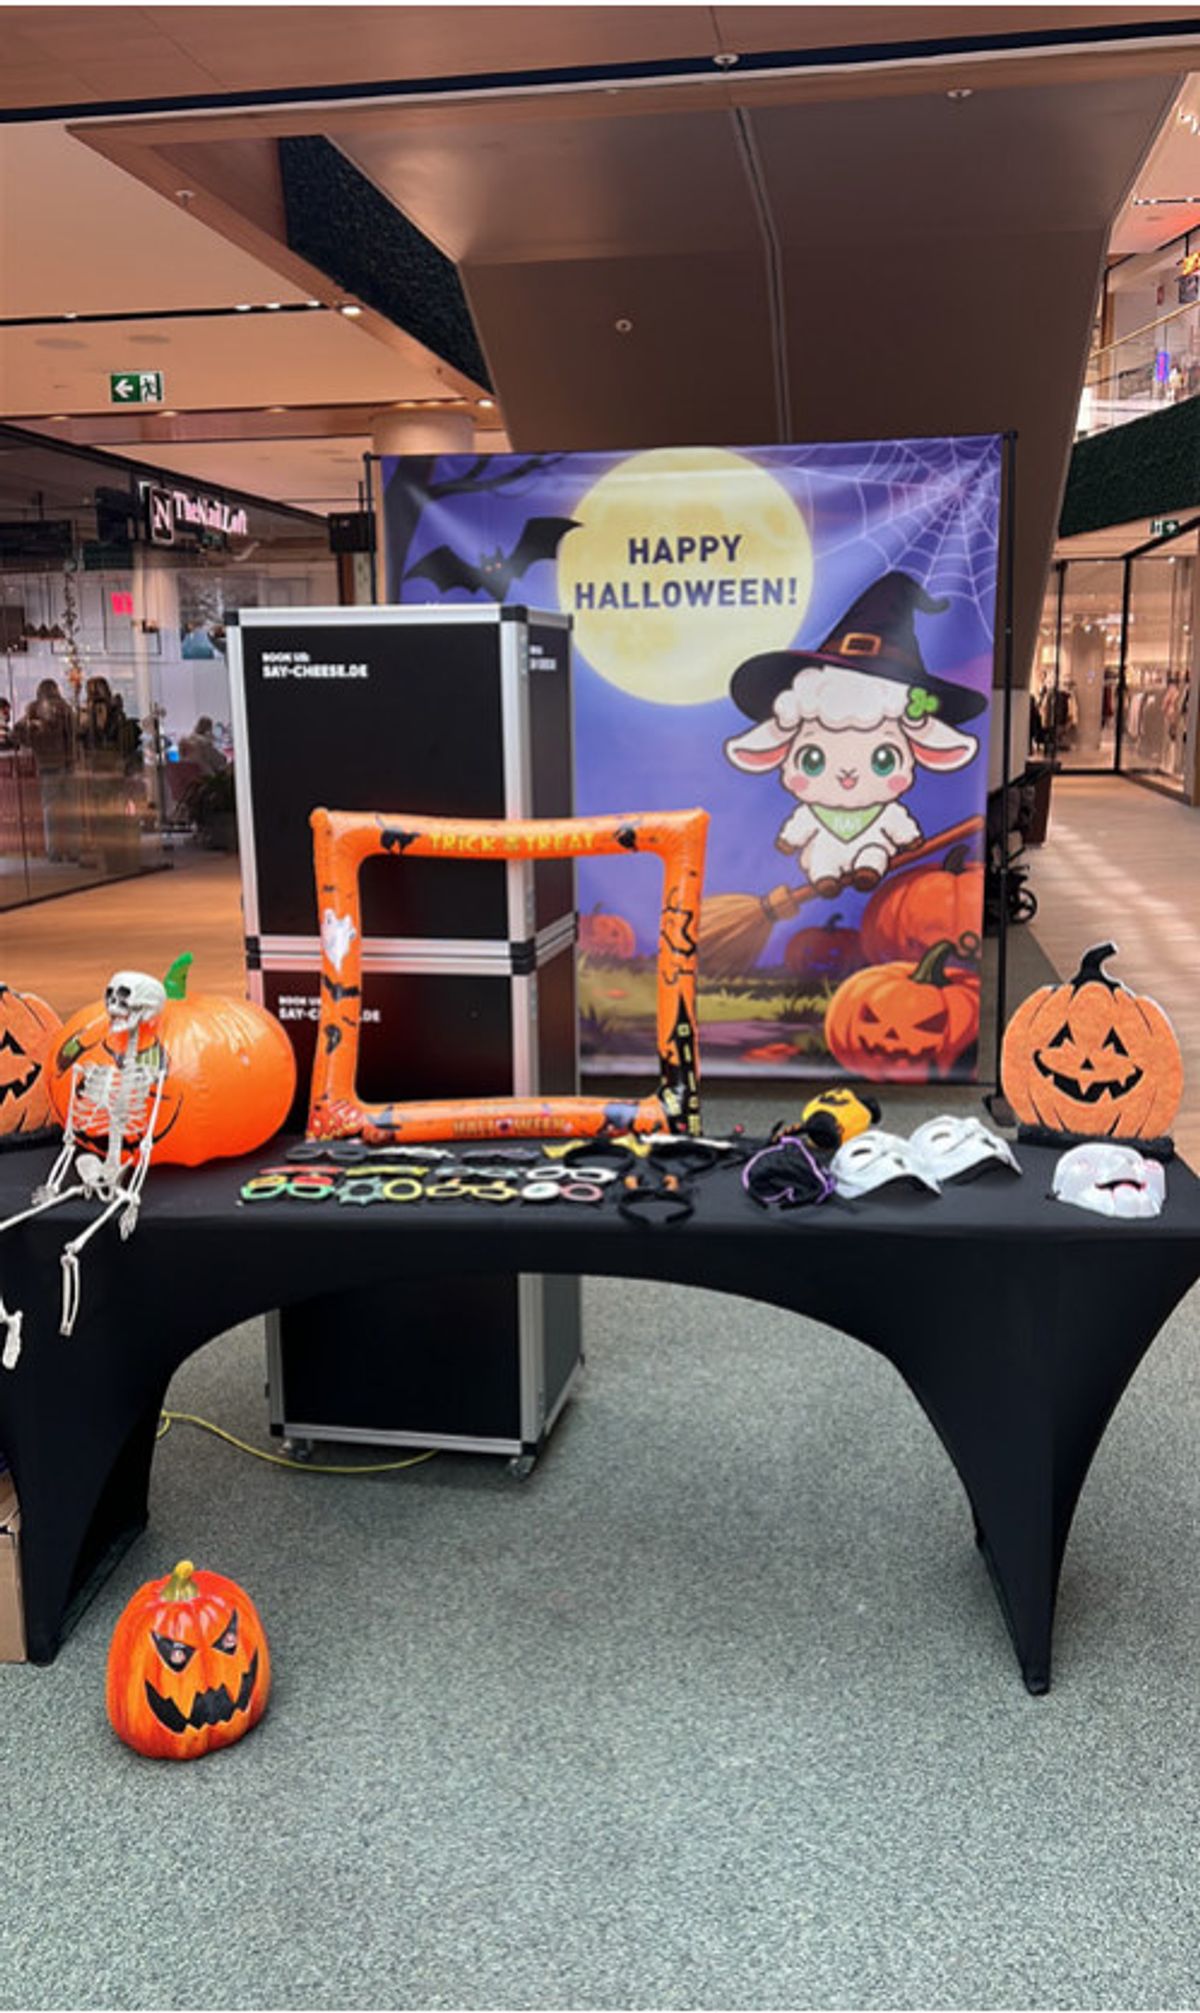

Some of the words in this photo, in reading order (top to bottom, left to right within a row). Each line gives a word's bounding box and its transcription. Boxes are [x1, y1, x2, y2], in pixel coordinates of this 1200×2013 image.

[628, 534, 743, 565] HAPPY
[574, 577, 798, 610] HALLOWEEN!
[262, 664, 368, 678] SAY-CHEESE.DE
[429, 831, 496, 851] TRICK
[525, 831, 595, 851] TREAT
